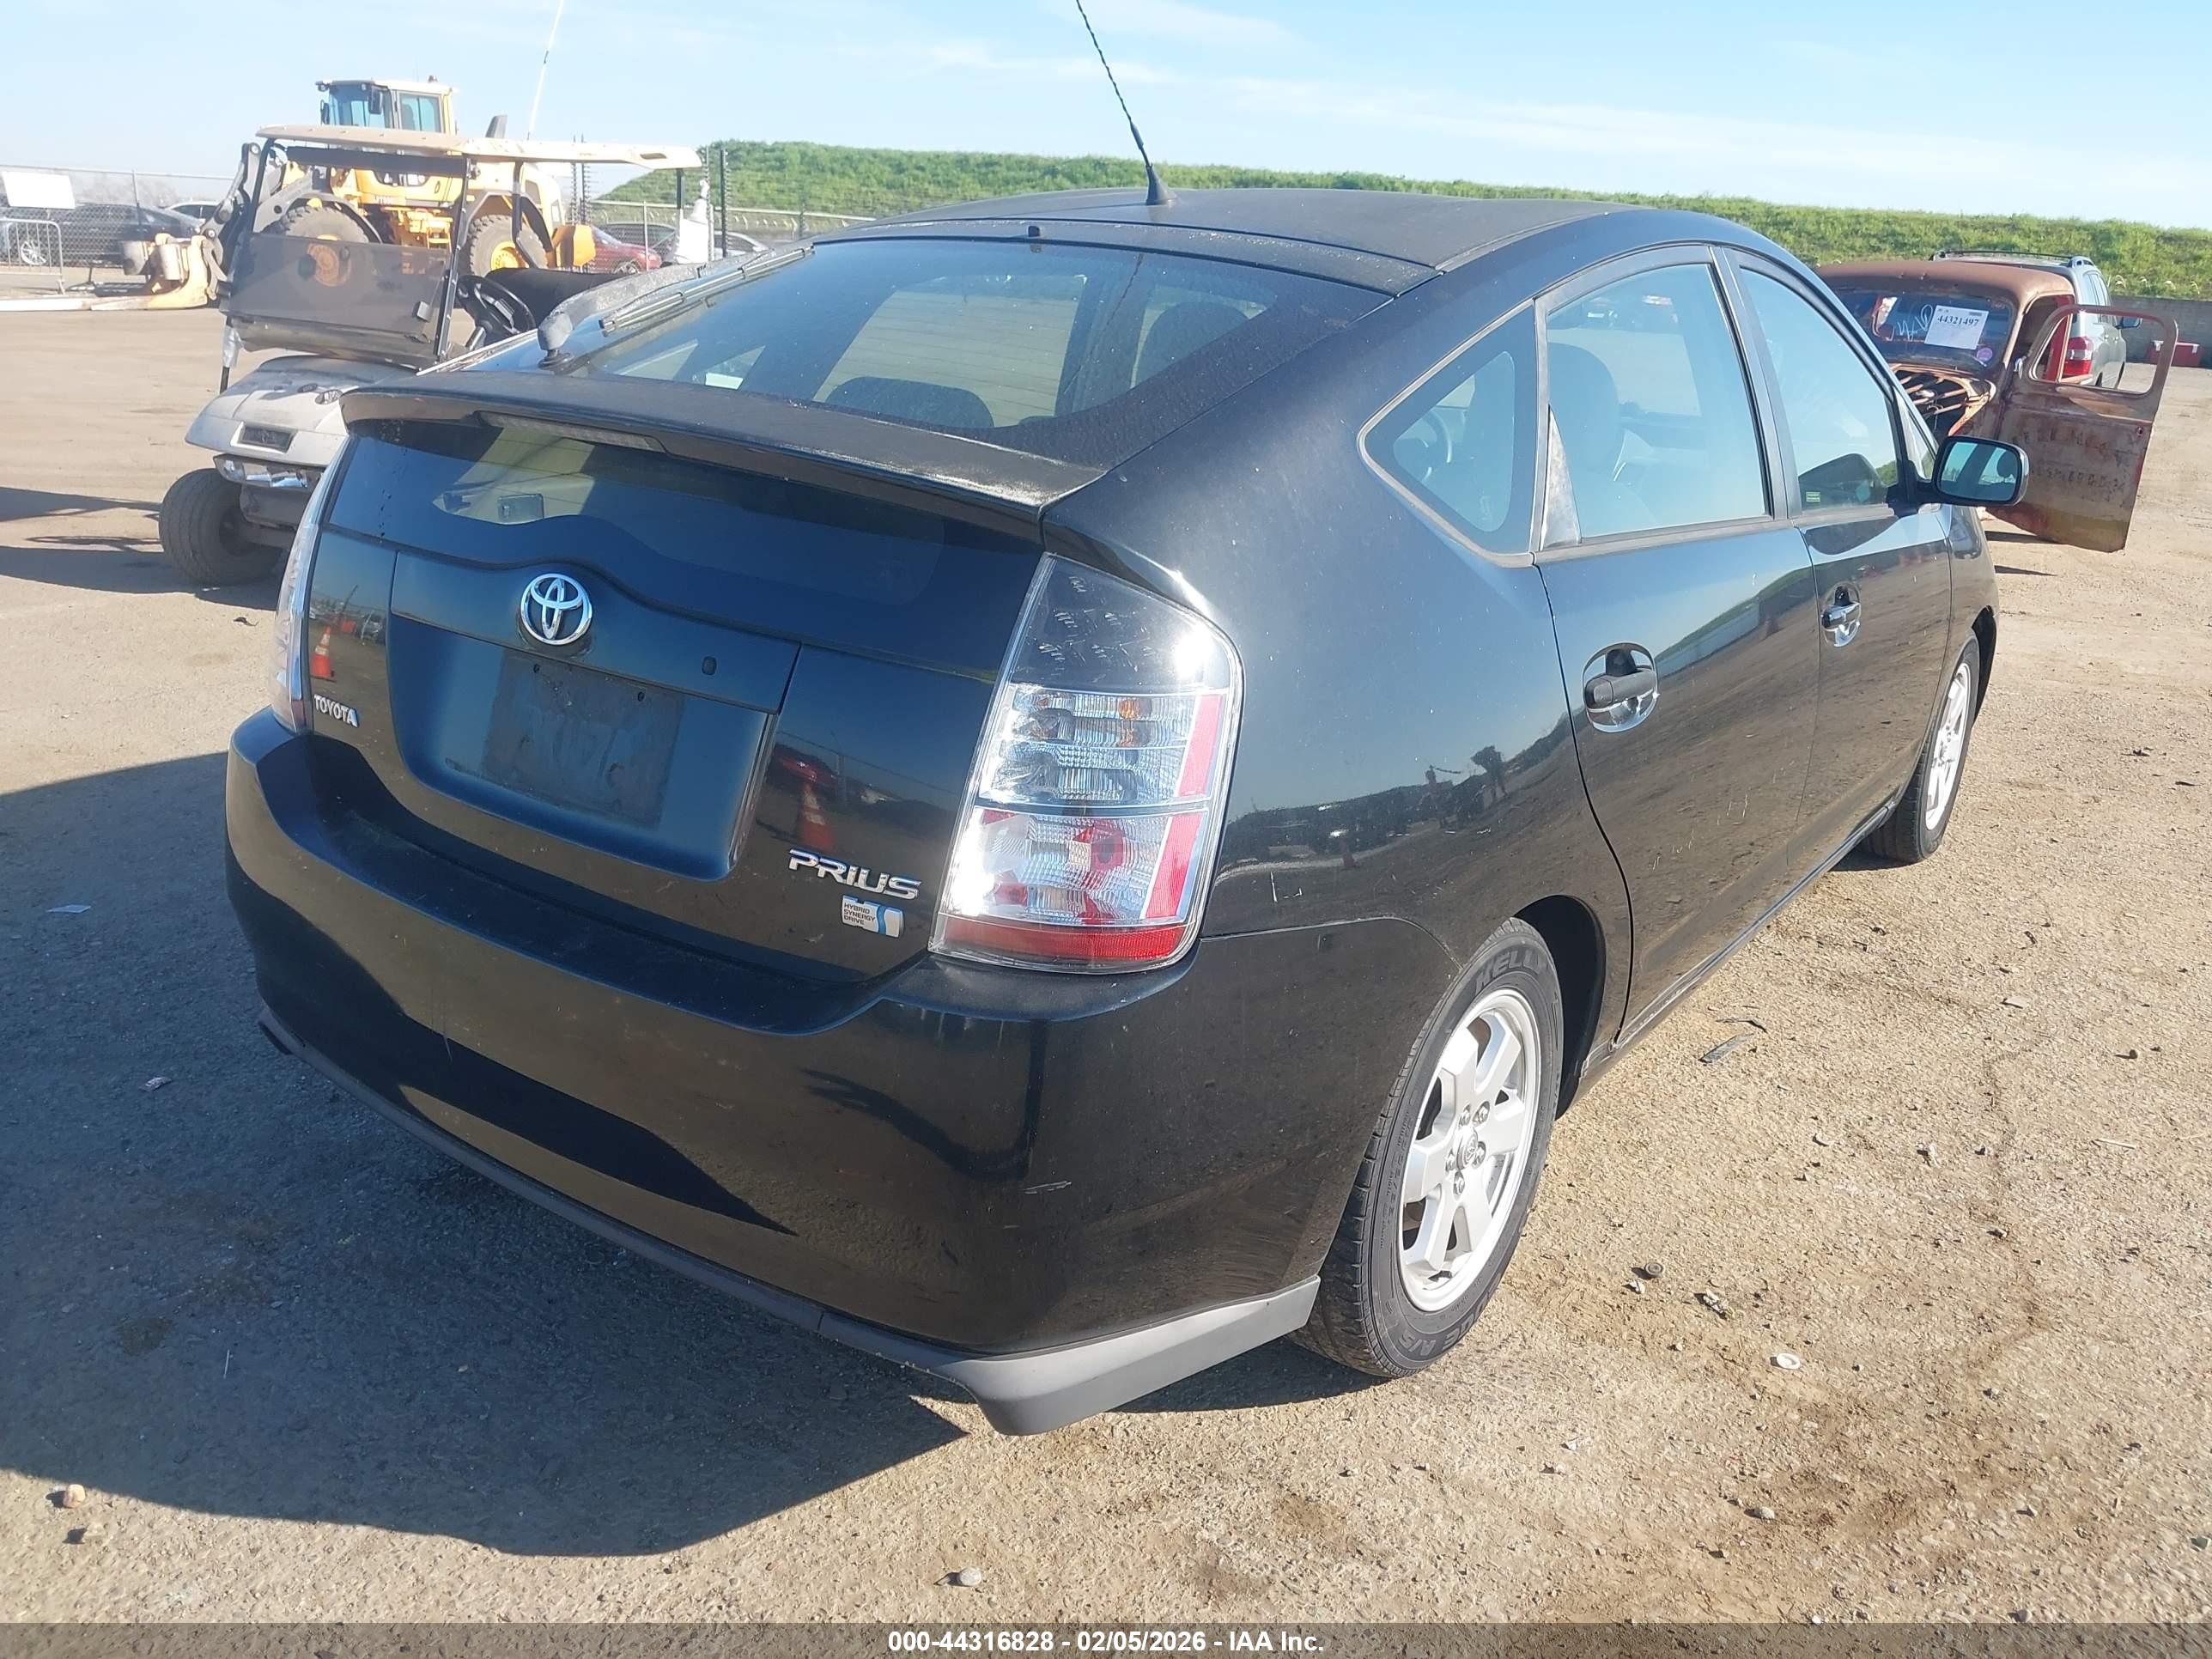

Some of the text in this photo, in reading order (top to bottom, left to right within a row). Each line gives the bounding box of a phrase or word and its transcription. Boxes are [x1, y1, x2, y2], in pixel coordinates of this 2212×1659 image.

[1936, 314, 1980, 326] 44321497
[314, 694, 358, 727] TOYOTA
[788, 848, 922, 900] PRIUS
[843, 908, 876, 922] SYNERGY
[844, 902, 870, 915] HYBRID
[843, 915, 865, 926] DRIVE
